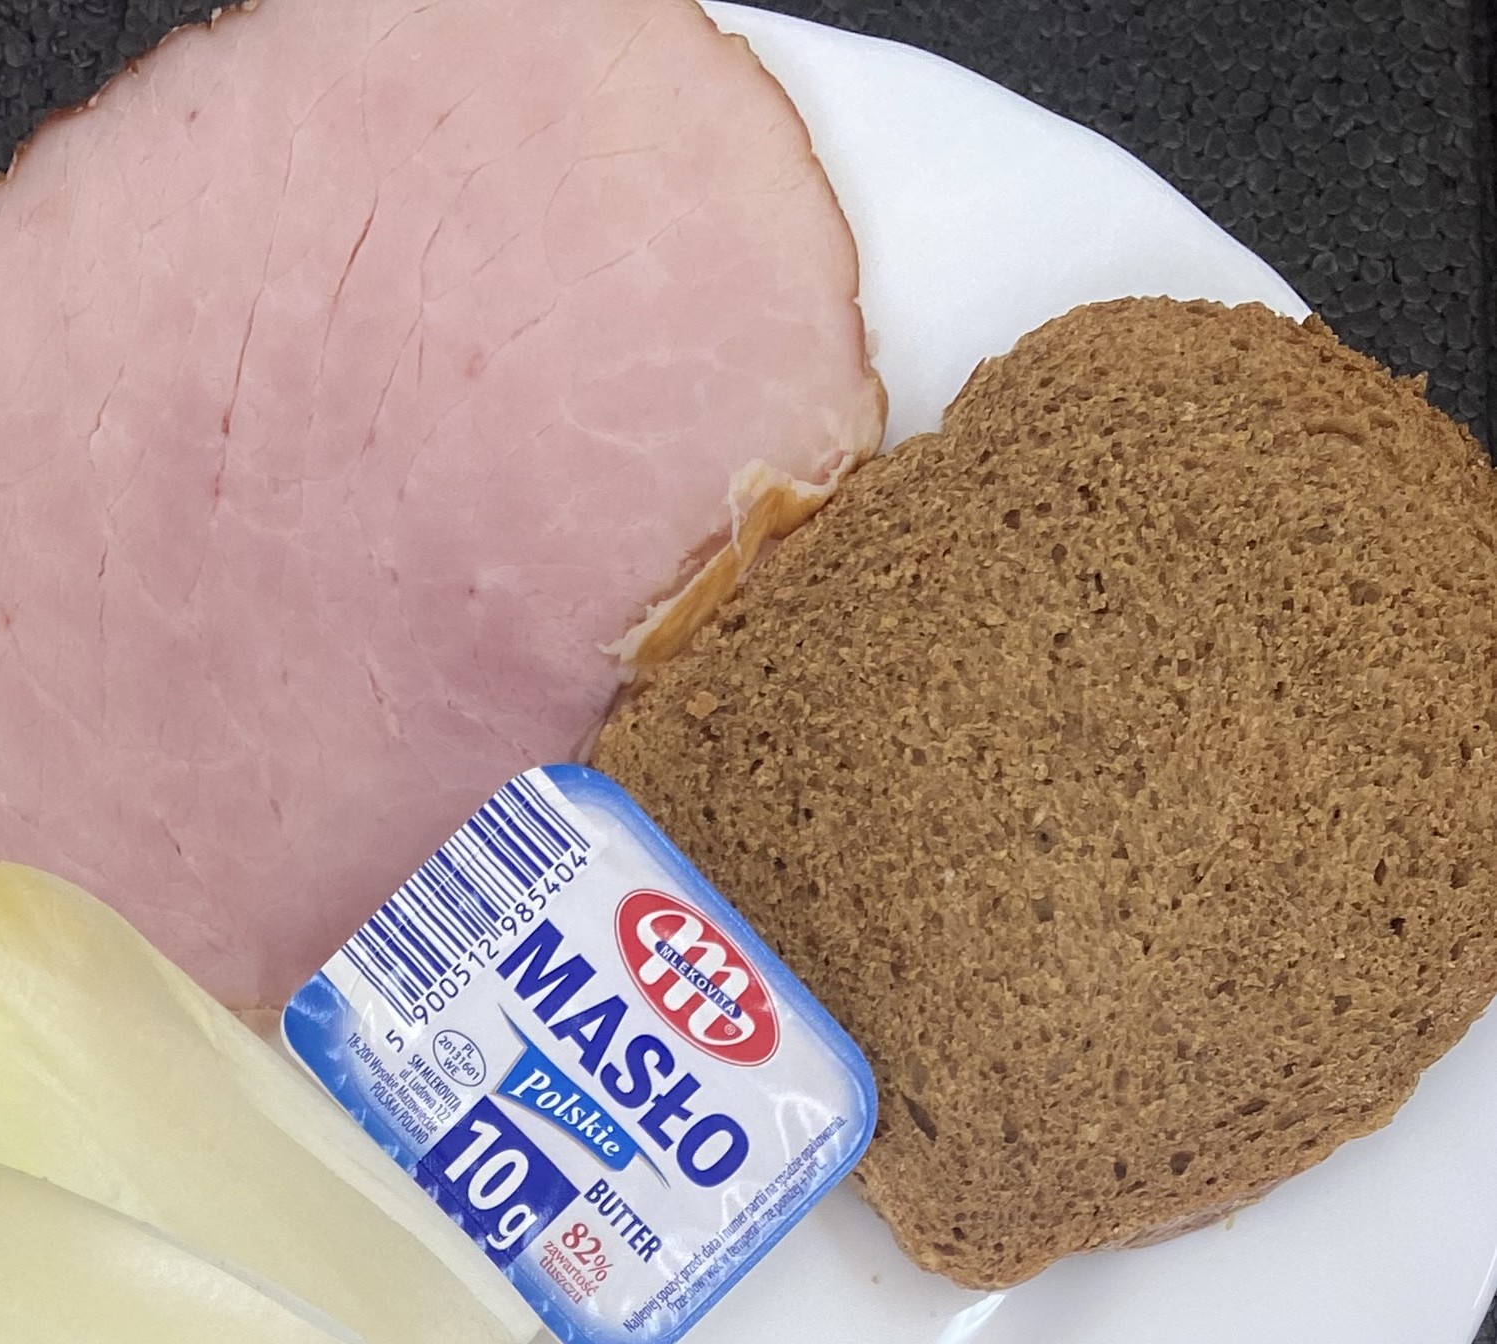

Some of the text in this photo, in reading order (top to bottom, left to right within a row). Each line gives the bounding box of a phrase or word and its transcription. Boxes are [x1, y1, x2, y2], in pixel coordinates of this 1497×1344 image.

[385, 851, 587, 1053] 5 900512 985404
[660, 945, 735, 1015] MLEKOVITA
[438, 1035, 480, 1081] 20131601
[443, 1057, 460, 1076] WE
[461, 1043, 475, 1059] PL
[495, 918, 749, 1187] MASŁO
[345, 1032, 438, 1135] 18-200 Wysokie Mazowieckie
[399, 1069, 451, 1124] ul. Ludowa 122
[407, 1054, 461, 1112] SM MLEKOVITA
[508, 1068, 619, 1156] Polskie
[584, 1178, 662, 1263] BUTTER
[539, 1256, 583, 1305] tłuszczu
[543, 1240, 599, 1297] zawartość
[562, 1223, 613, 1282] 82%
